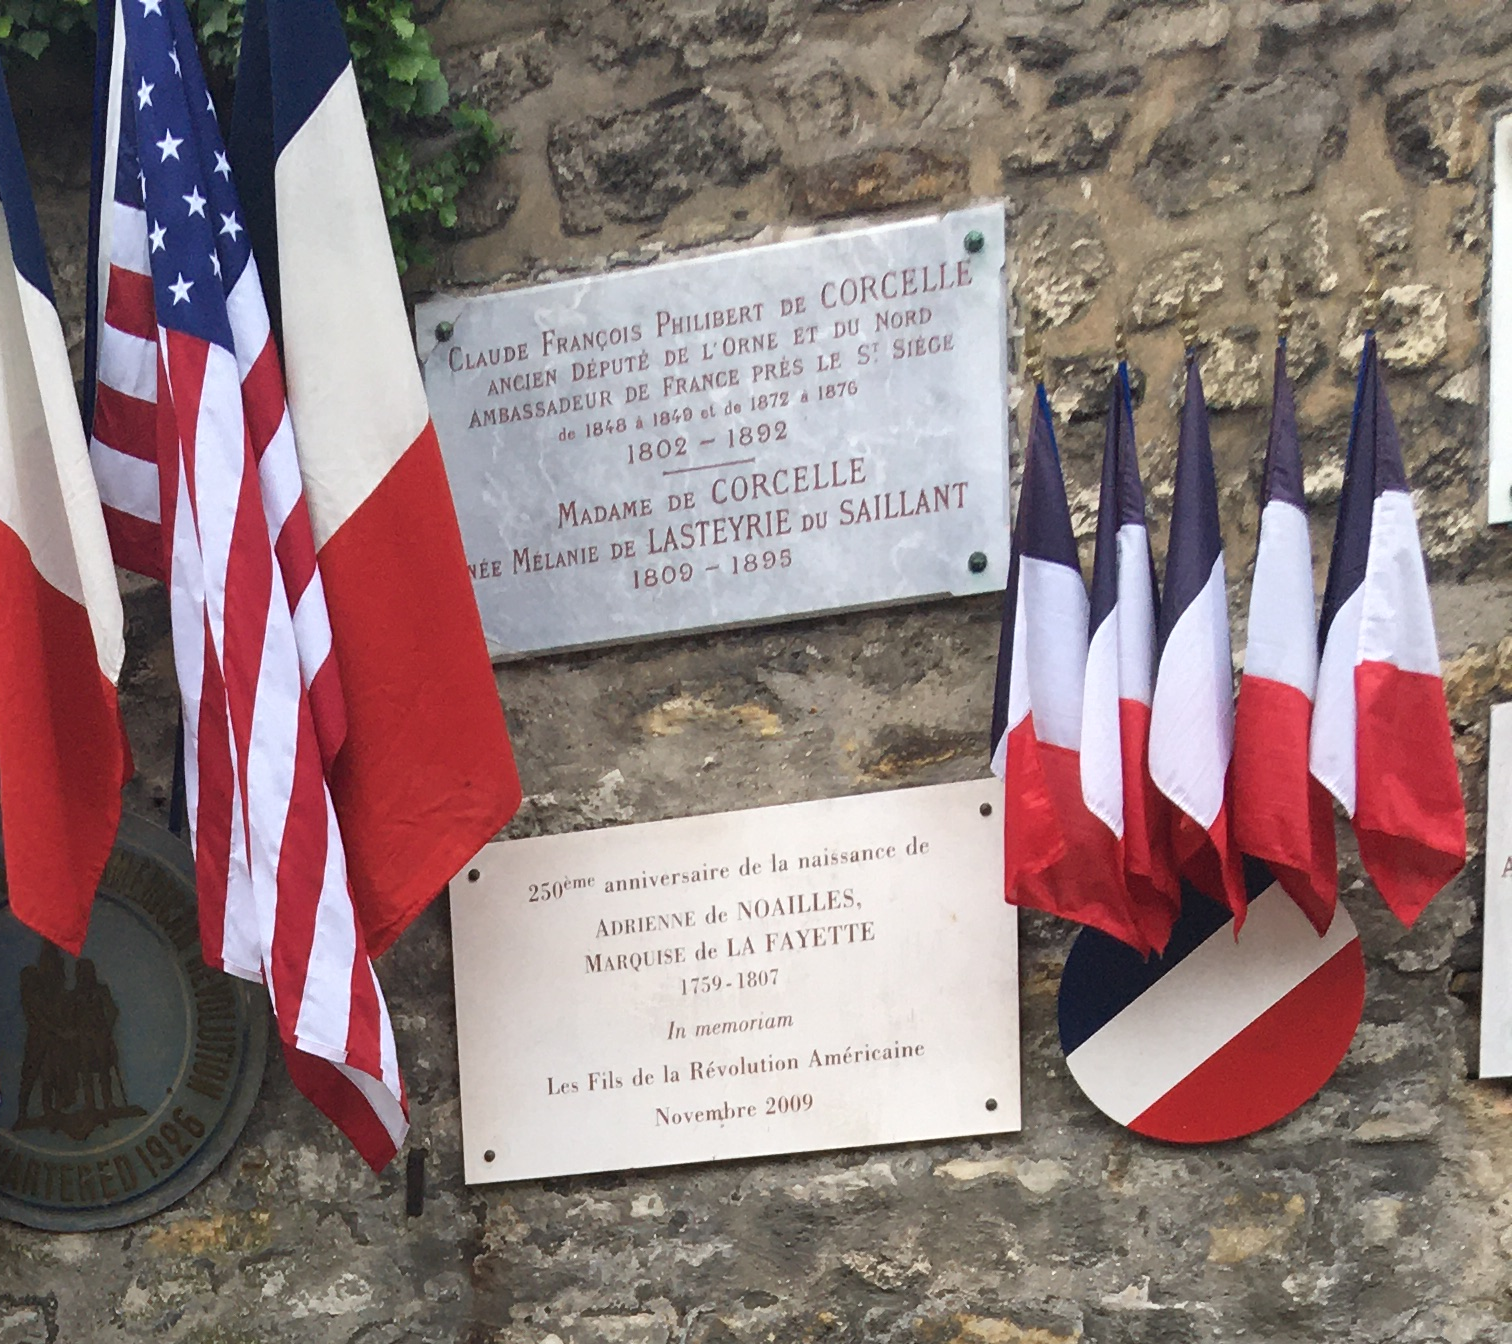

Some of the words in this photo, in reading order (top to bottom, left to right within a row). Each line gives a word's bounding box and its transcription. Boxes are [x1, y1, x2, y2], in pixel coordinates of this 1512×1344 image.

[448, 343, 529, 372] CLAUDE
[542, 325, 642, 357] FRANÇOIS
[656, 303, 764, 338] PHILIBERT
[781, 296, 806, 317] DE
[820, 259, 973, 309] CORCELLE
[488, 369, 558, 396] ANCIEN
[665, 347, 689, 367] DE
[793, 326, 818, 345] ET
[834, 318, 860, 339] DU
[875, 307, 932, 332] NORD
[469, 390, 613, 428] AMBASSADEUR
[625, 384, 650, 404] DE
[663, 369, 739, 397] FRANCE
[817, 353, 842, 372] LE
[559, 428, 575, 441] de
[586, 418, 627, 438] 1848
[653, 407, 692, 426] 1849
[701, 406, 715, 419] et
[724, 401, 741, 415] de
[751, 392, 789, 411] 1872
[819, 381, 857, 401] 1876
[628, 437, 687, 464] 1802
[729, 421, 787, 448] 1892
[558, 498, 653, 529] MADAME
[668, 491, 696, 511] DE
[711, 457, 868, 505] CORCELLE
[610, 539, 637, 559] DE
[647, 509, 792, 555] LASTEYRIE
[801, 511, 828, 533] DU
[839, 482, 970, 527] SAILLANT
[632, 562, 695, 590] 1809
[732, 549, 793, 575] 1895
[528, 874, 596, 904] 250ème
[603, 863, 731, 895] anniversaire
[738, 856, 764, 877] de
[770, 853, 790, 873] la
[797, 842, 897, 871] naissance
[905, 837, 930, 857] de
[596, 910, 696, 939] ADRIENNE
[705, 905, 729, 926] de
[736, 887, 863, 922] NOAILLES,
[584, 945, 687, 975] MARQUISE
[694, 941, 719, 962] de
[726, 935, 757, 958] LA
[765, 921, 876, 954] FAYETTE
[667, 1020, 687, 1041] In
[694, 1010, 794, 1038] memoriam
[547, 1074, 579, 1096] Les
[587, 1069, 624, 1093] Fils
[631, 1067, 656, 1086] de
[662, 1064, 681, 1083] la
[689, 1052, 800, 1082] Révolution
[808, 1039, 926, 1069] Américaine
[655, 1100, 758, 1127] Novembre
[765, 1092, 814, 1117] 2009
